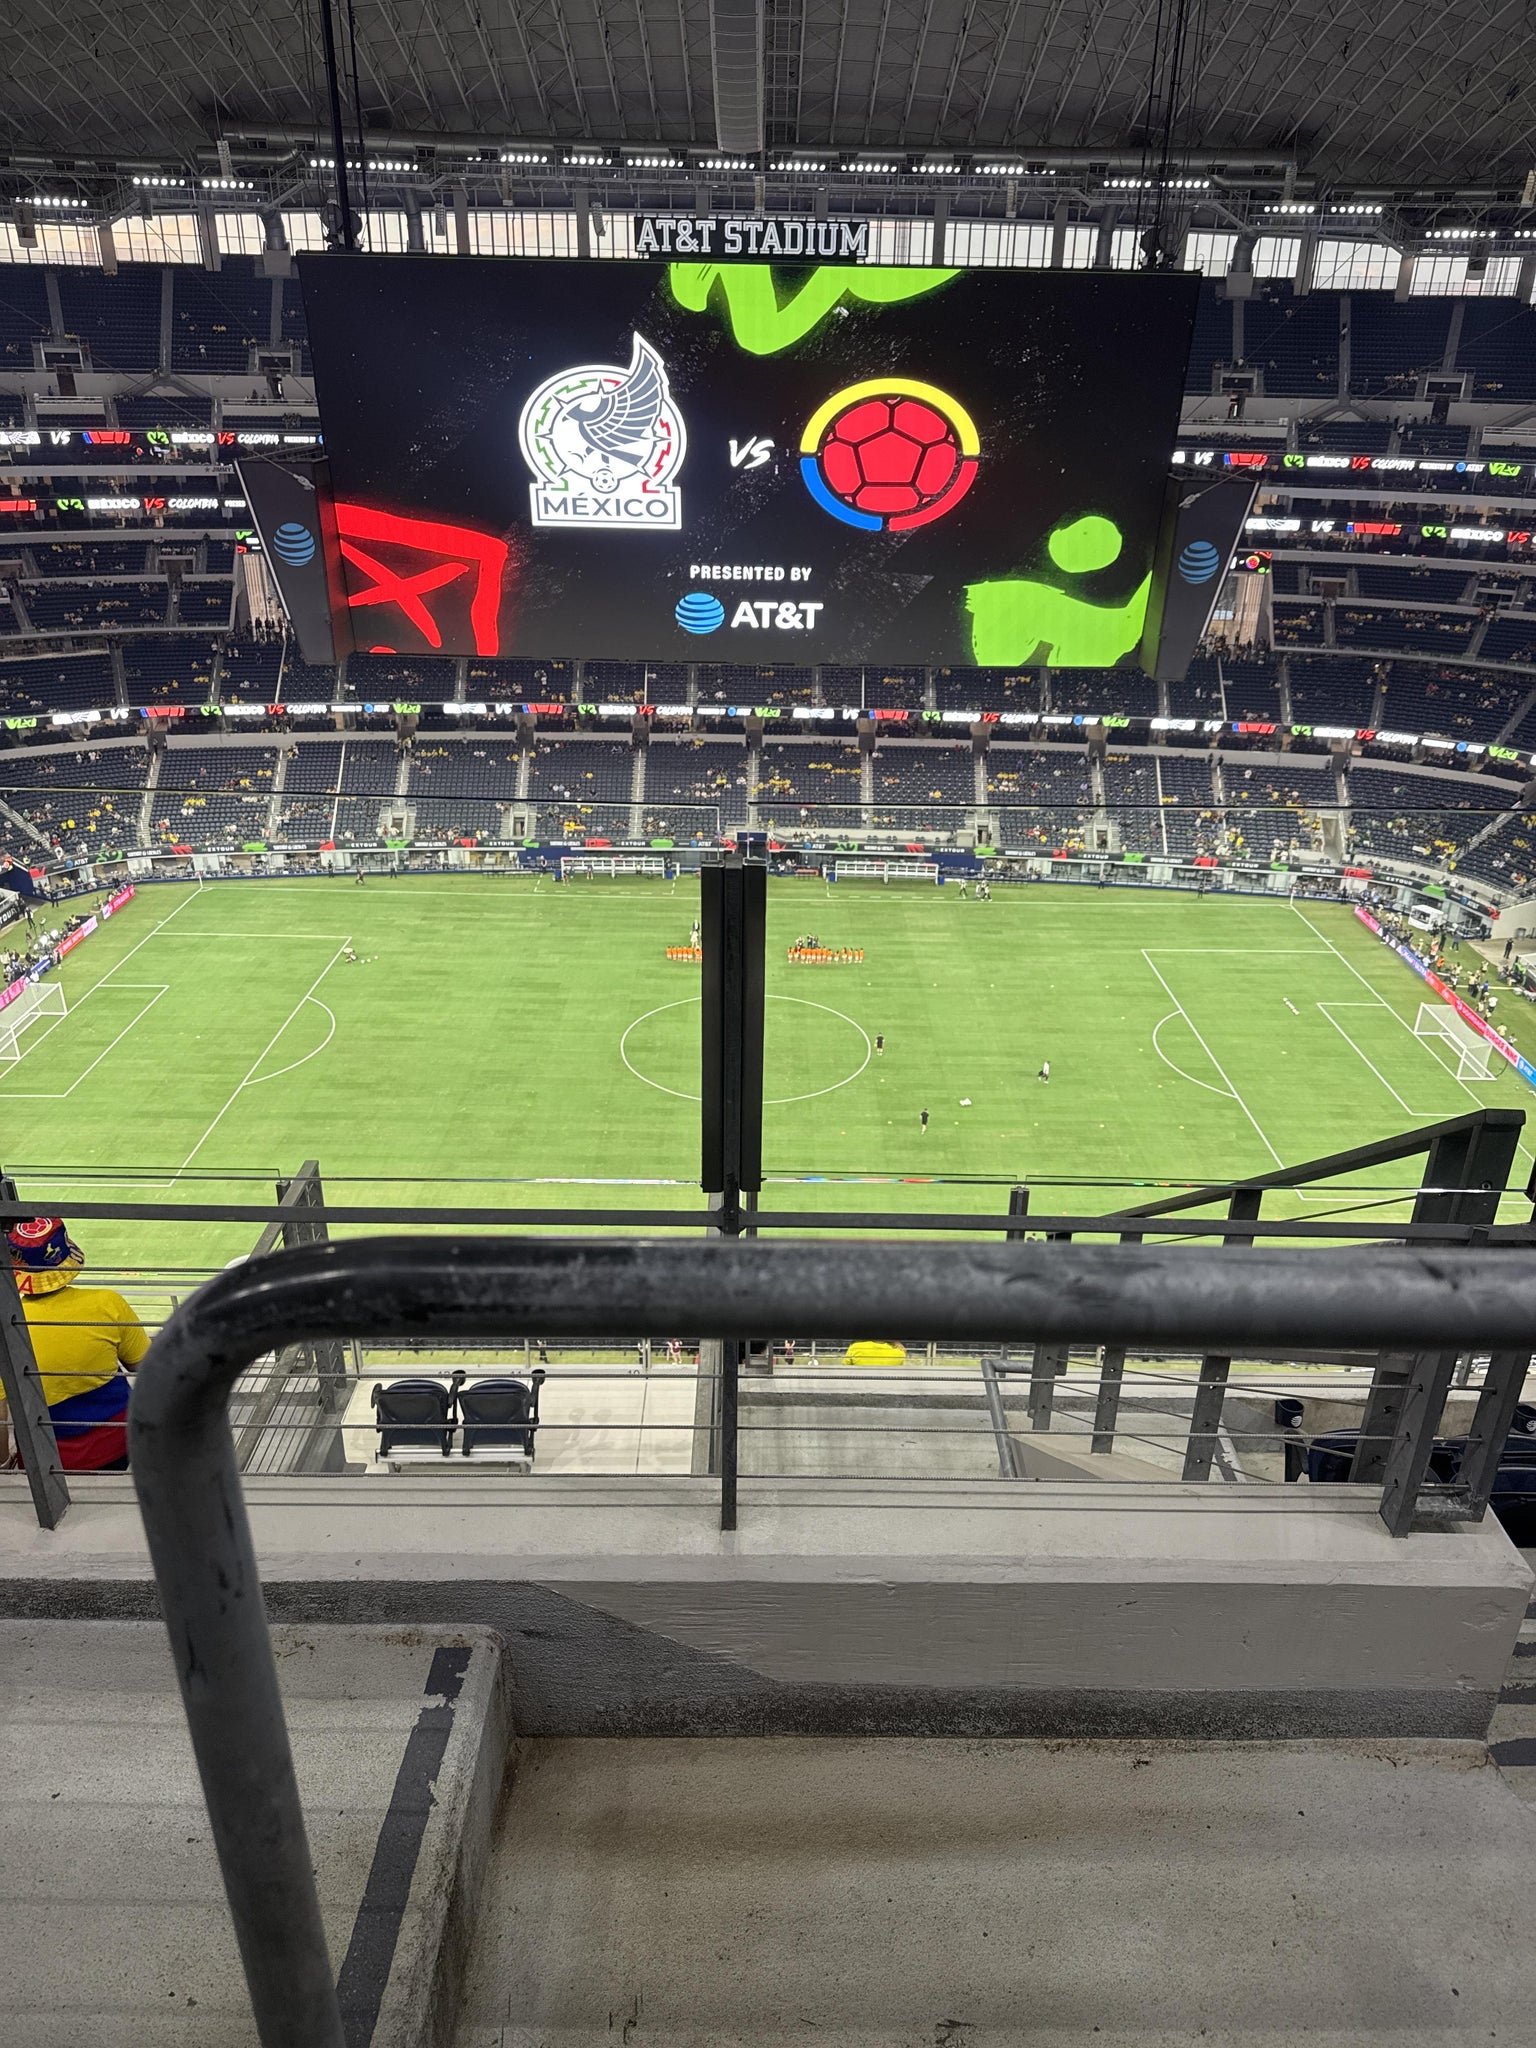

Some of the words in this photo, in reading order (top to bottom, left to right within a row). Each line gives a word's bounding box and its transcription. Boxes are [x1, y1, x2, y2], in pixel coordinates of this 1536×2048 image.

[636, 219, 716, 253] AT&T
[725, 221, 868, 256] STADIUM
[50, 431, 71, 445] VS
[218, 432, 236, 446] VS
[729, 435, 775, 470] VS
[1194, 452, 1214, 466] VS
[1351, 457, 1371, 470] VS
[143, 498, 165, 510] VS
[544, 492, 670, 518] MÉXICO
[1311, 520, 1335, 534] VS
[1507, 531, 1530, 544] VS
[690, 565, 785, 581] PRESENTED
[791, 567, 812, 582] BY
[730, 601, 824, 629] AT&T
